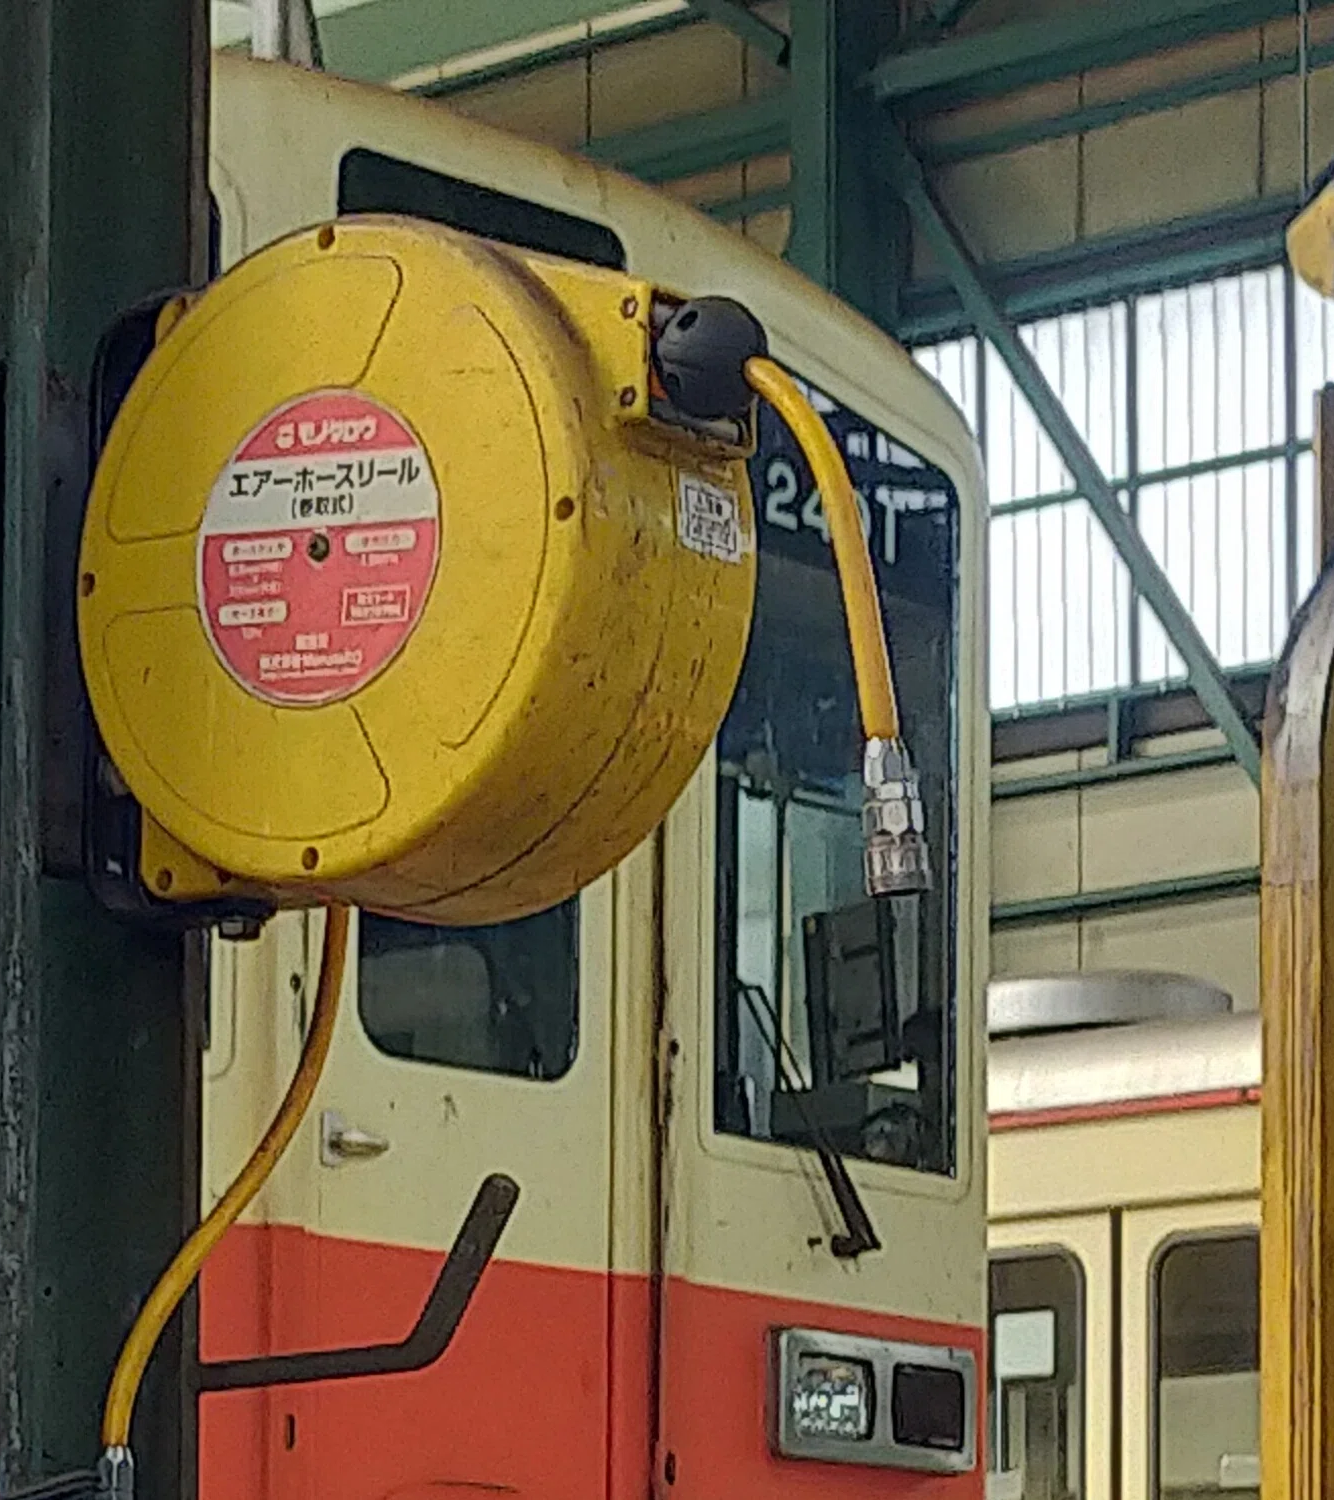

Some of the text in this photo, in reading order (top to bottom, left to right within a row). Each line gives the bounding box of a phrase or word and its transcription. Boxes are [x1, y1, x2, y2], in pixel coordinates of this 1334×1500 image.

[229, 455, 420, 498] エアーホースリール
